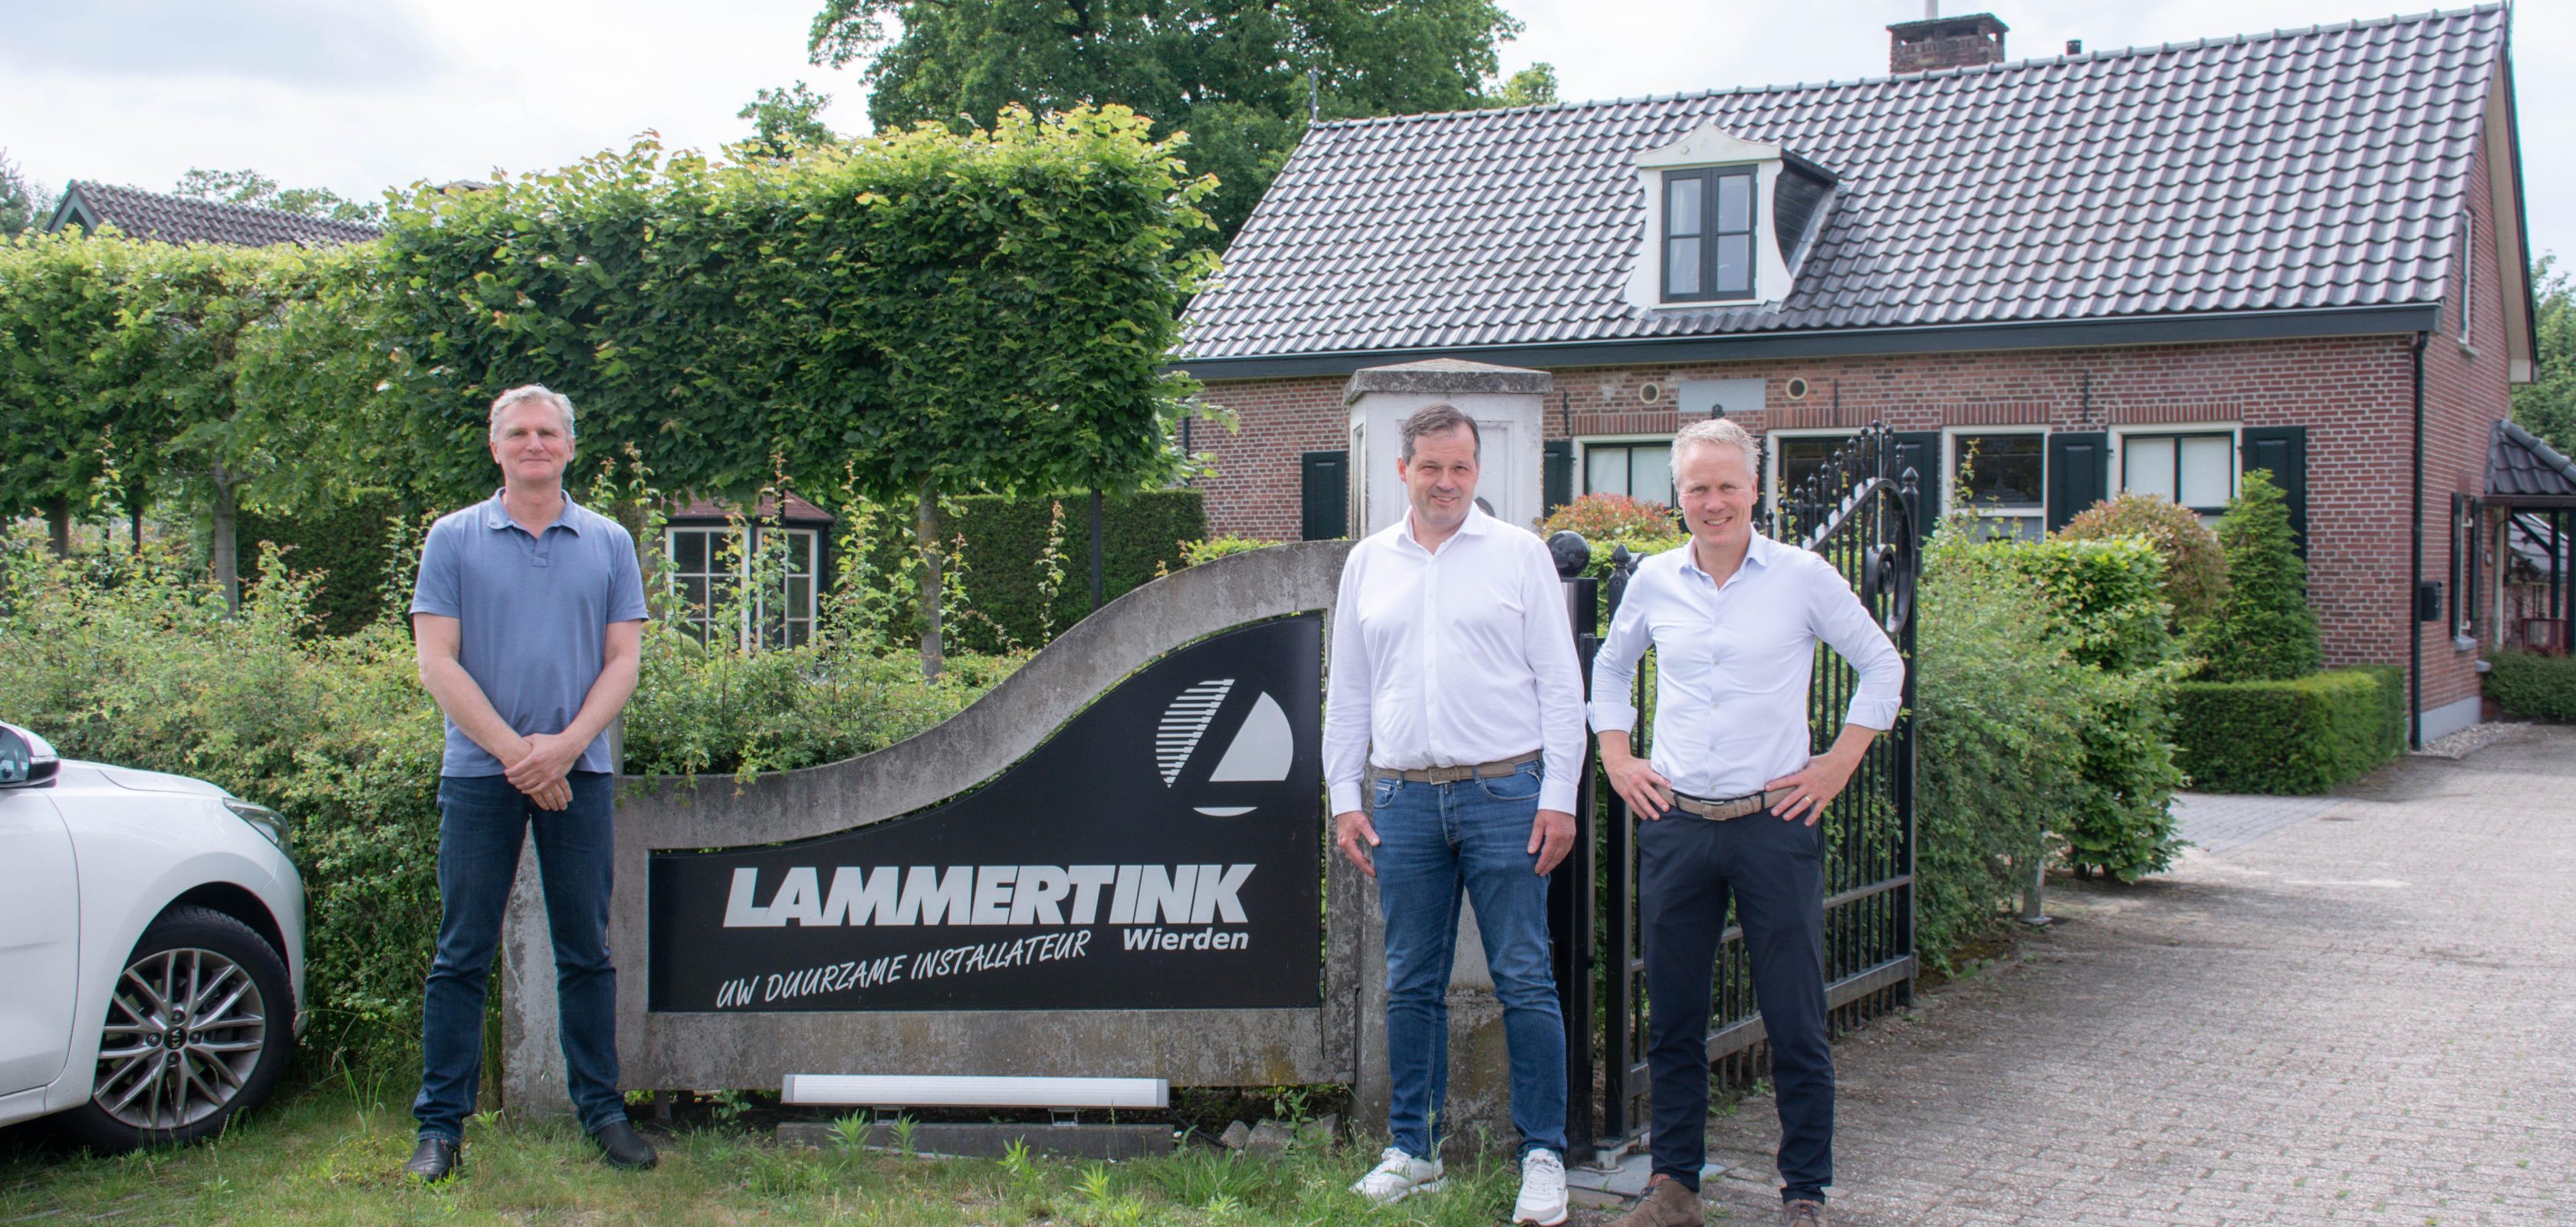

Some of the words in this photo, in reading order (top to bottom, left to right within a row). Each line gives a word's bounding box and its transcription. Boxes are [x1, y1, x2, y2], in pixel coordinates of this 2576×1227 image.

[723, 864, 1257, 928] LAMMERTINK
[1123, 926, 1249, 951] Wierden
[716, 975, 761, 1008] UW
[764, 954, 909, 1003] DUURZAME
[910, 929, 1092, 981] INSTALLATEUR
[171, 1028, 181, 1048] KIA
